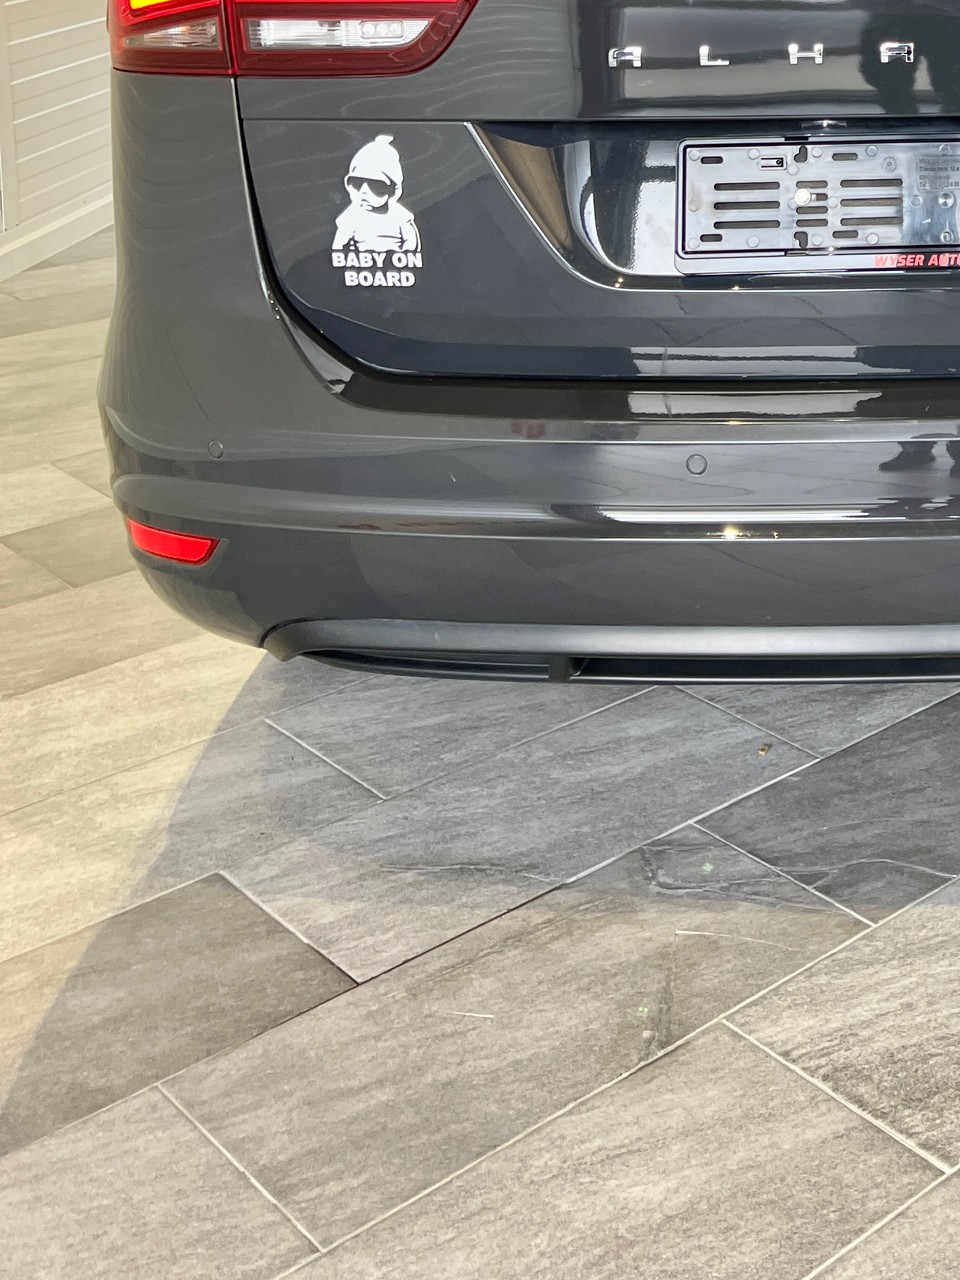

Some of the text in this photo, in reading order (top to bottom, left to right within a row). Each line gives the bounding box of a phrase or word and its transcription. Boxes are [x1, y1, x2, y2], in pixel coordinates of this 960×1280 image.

[331, 252, 423, 268] BABY ON
[874, 254, 924, 269] WYSER
[344, 271, 416, 287] BOARD
